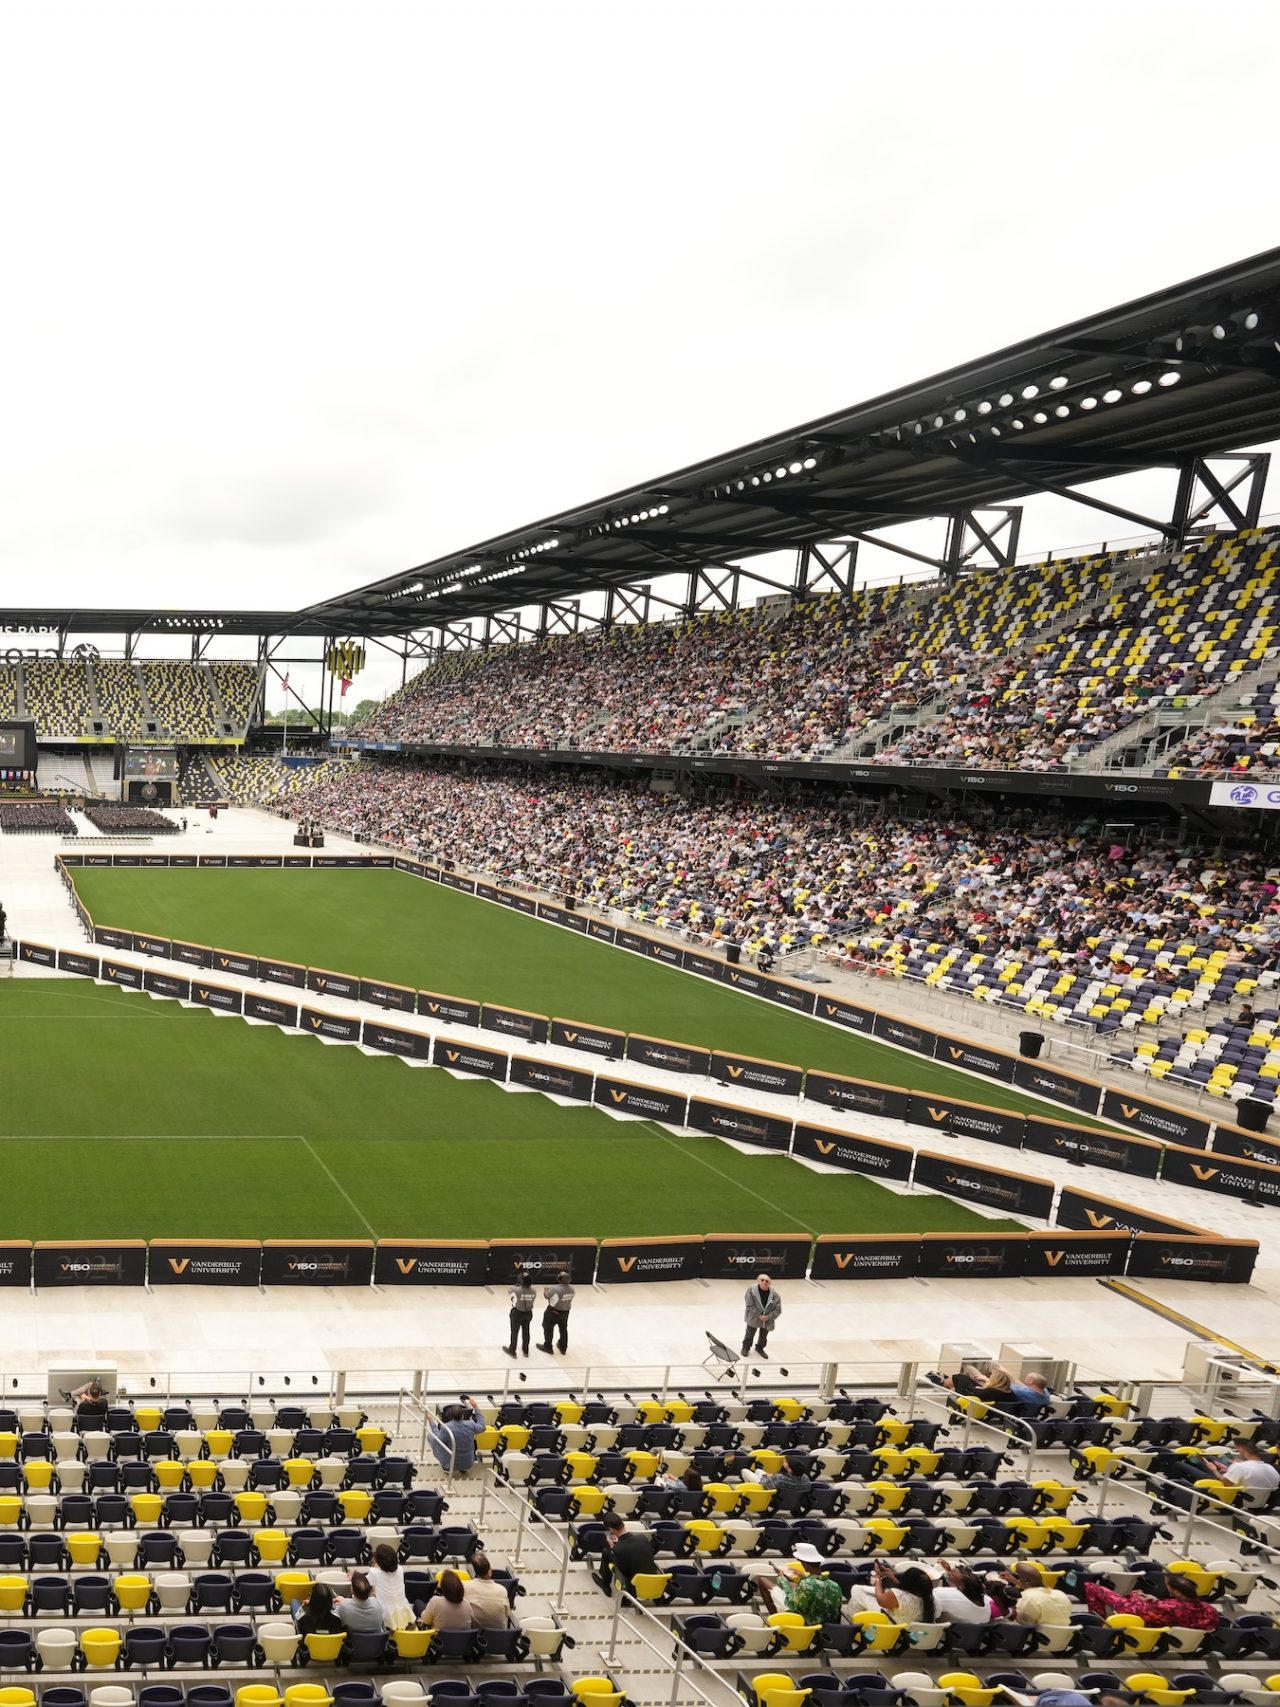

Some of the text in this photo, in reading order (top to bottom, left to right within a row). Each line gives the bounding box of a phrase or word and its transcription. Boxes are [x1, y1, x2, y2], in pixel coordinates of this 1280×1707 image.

[18, 626, 60, 638] PARK
[960, 776, 985, 784] V150
[1104, 783, 1139, 793] V150
[744, 1070, 787, 1083] VANDERBILT
[744, 1074, 785, 1086] UNIVERSITY
[1034, 1077, 1059, 1089] V150
[627, 1099, 668, 1113] UNIVERSITY
[628, 1095, 670, 1109] VANDERBILT
[711, 1116, 742, 1128] V150
[1139, 1112, 1189, 1132] VANDERBILT
[1139, 1116, 1186, 1136] UNIVERSITY
[837, 1146, 891, 1164] VANDERBILT
[837, 1151, 889, 1169] UNIVERSITY
[1242, 1149, 1277, 1165] V150
[946, 1175, 981, 1190] V150
[1220, 1172, 1280, 1190] VANDRBIL
[1220, 1178, 1280, 1196] UNIVERSIT
[514, 1261, 543, 1269] V150
[728, 1256, 756, 1264] V150
[946, 1255, 977, 1263] V150
[1161, 1257, 1194, 1266] V150
[61, 1263, 91, 1271] V150
[288, 1262, 318, 1270] V150
[637, 1262, 683, 1270] UNIVERSITY
